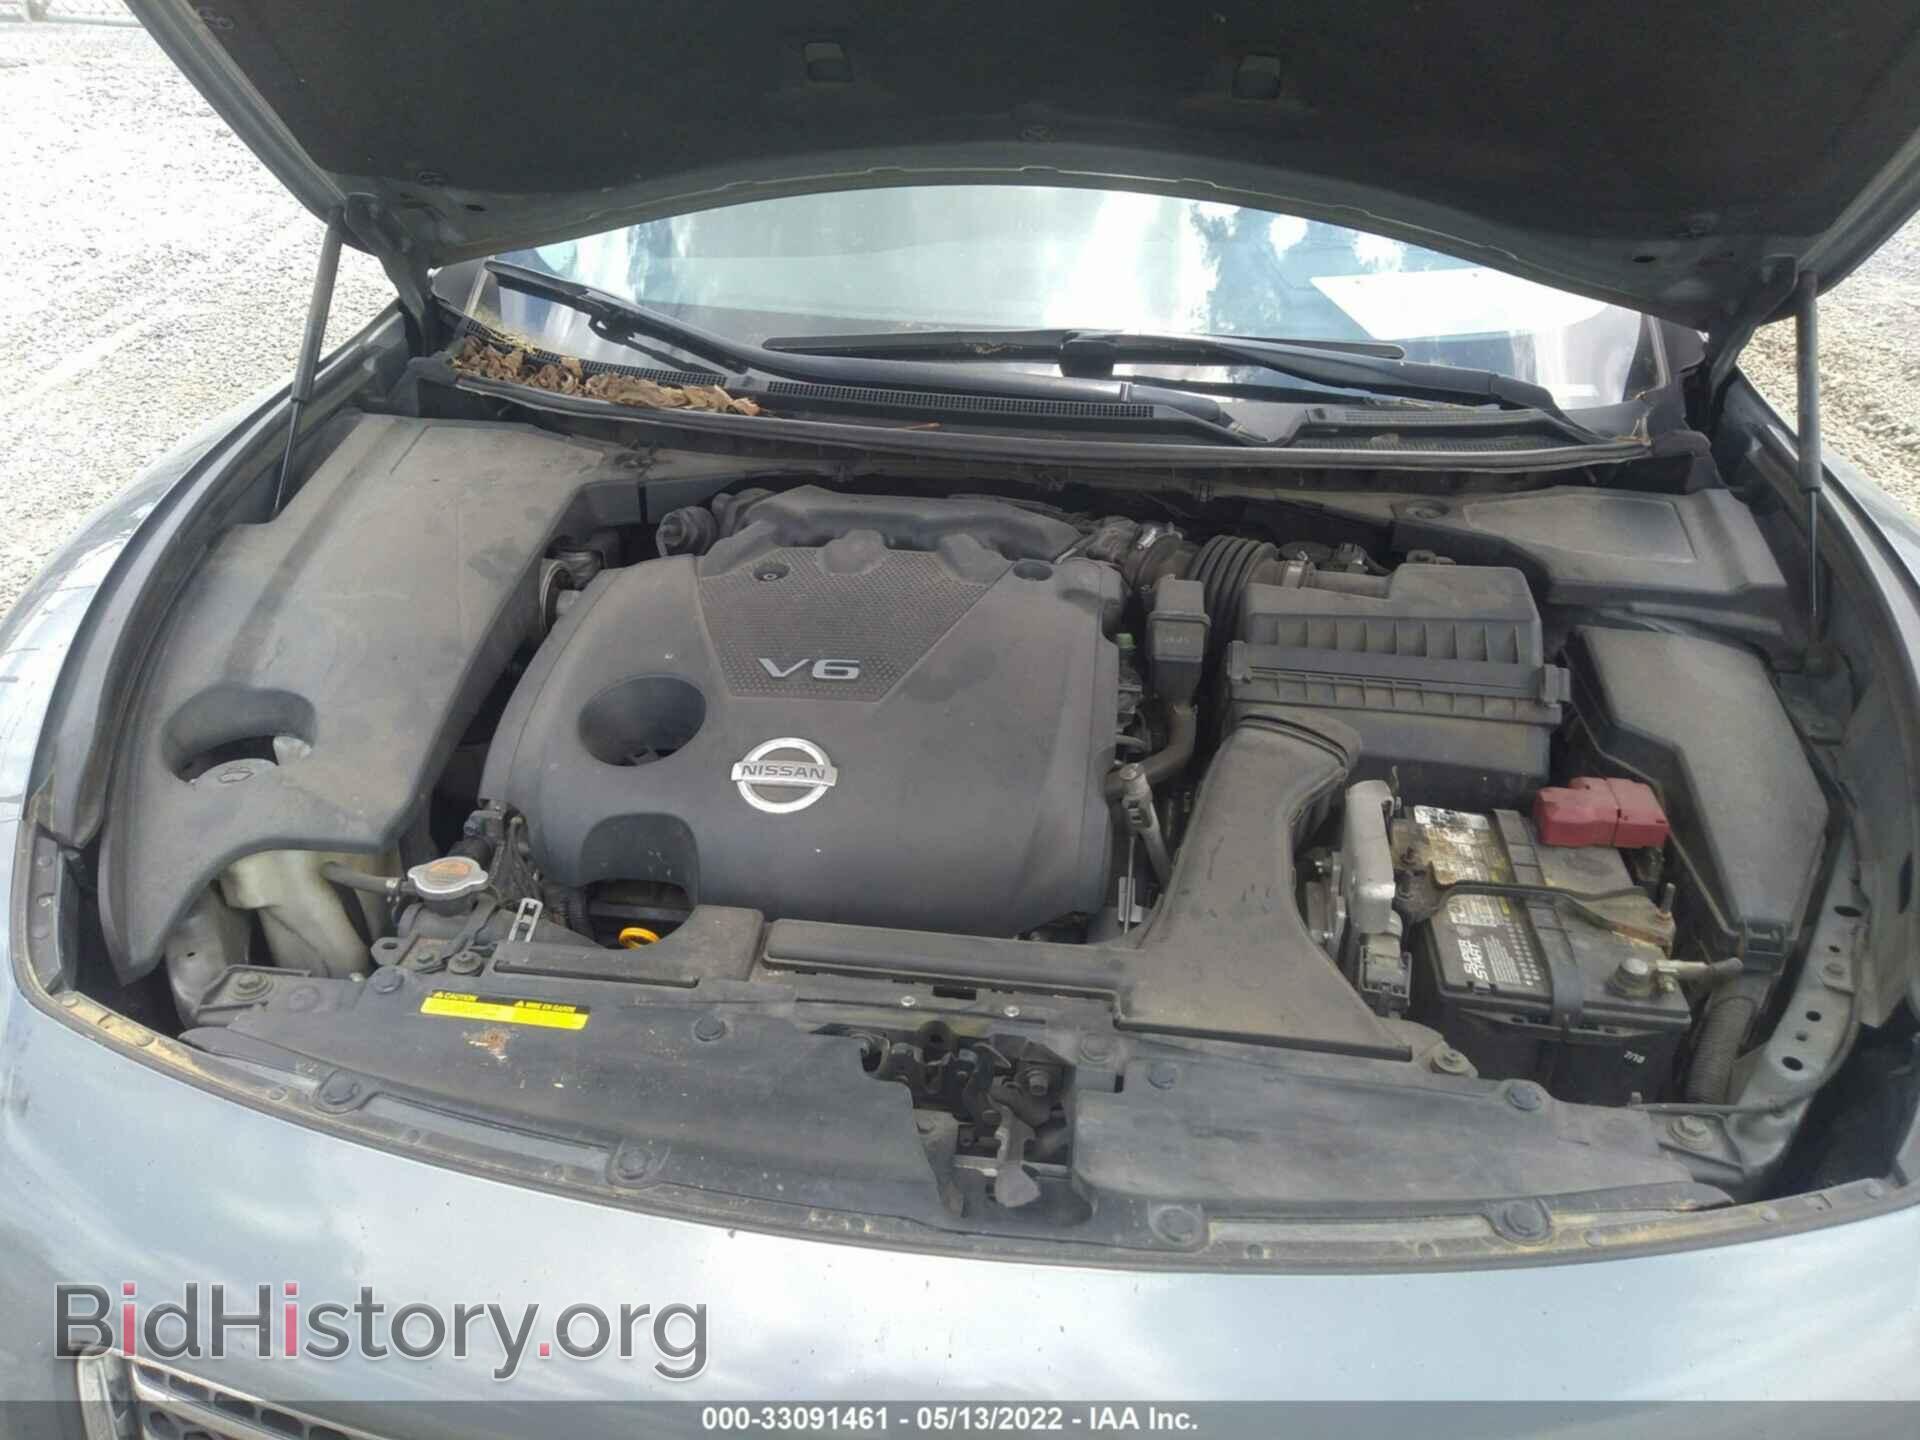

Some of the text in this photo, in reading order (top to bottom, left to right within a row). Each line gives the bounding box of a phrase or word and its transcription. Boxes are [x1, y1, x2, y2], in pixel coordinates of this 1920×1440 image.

[758, 657, 861, 680] V6
[742, 764, 826, 780] NISSAN
[1467, 941, 1490, 982] START
